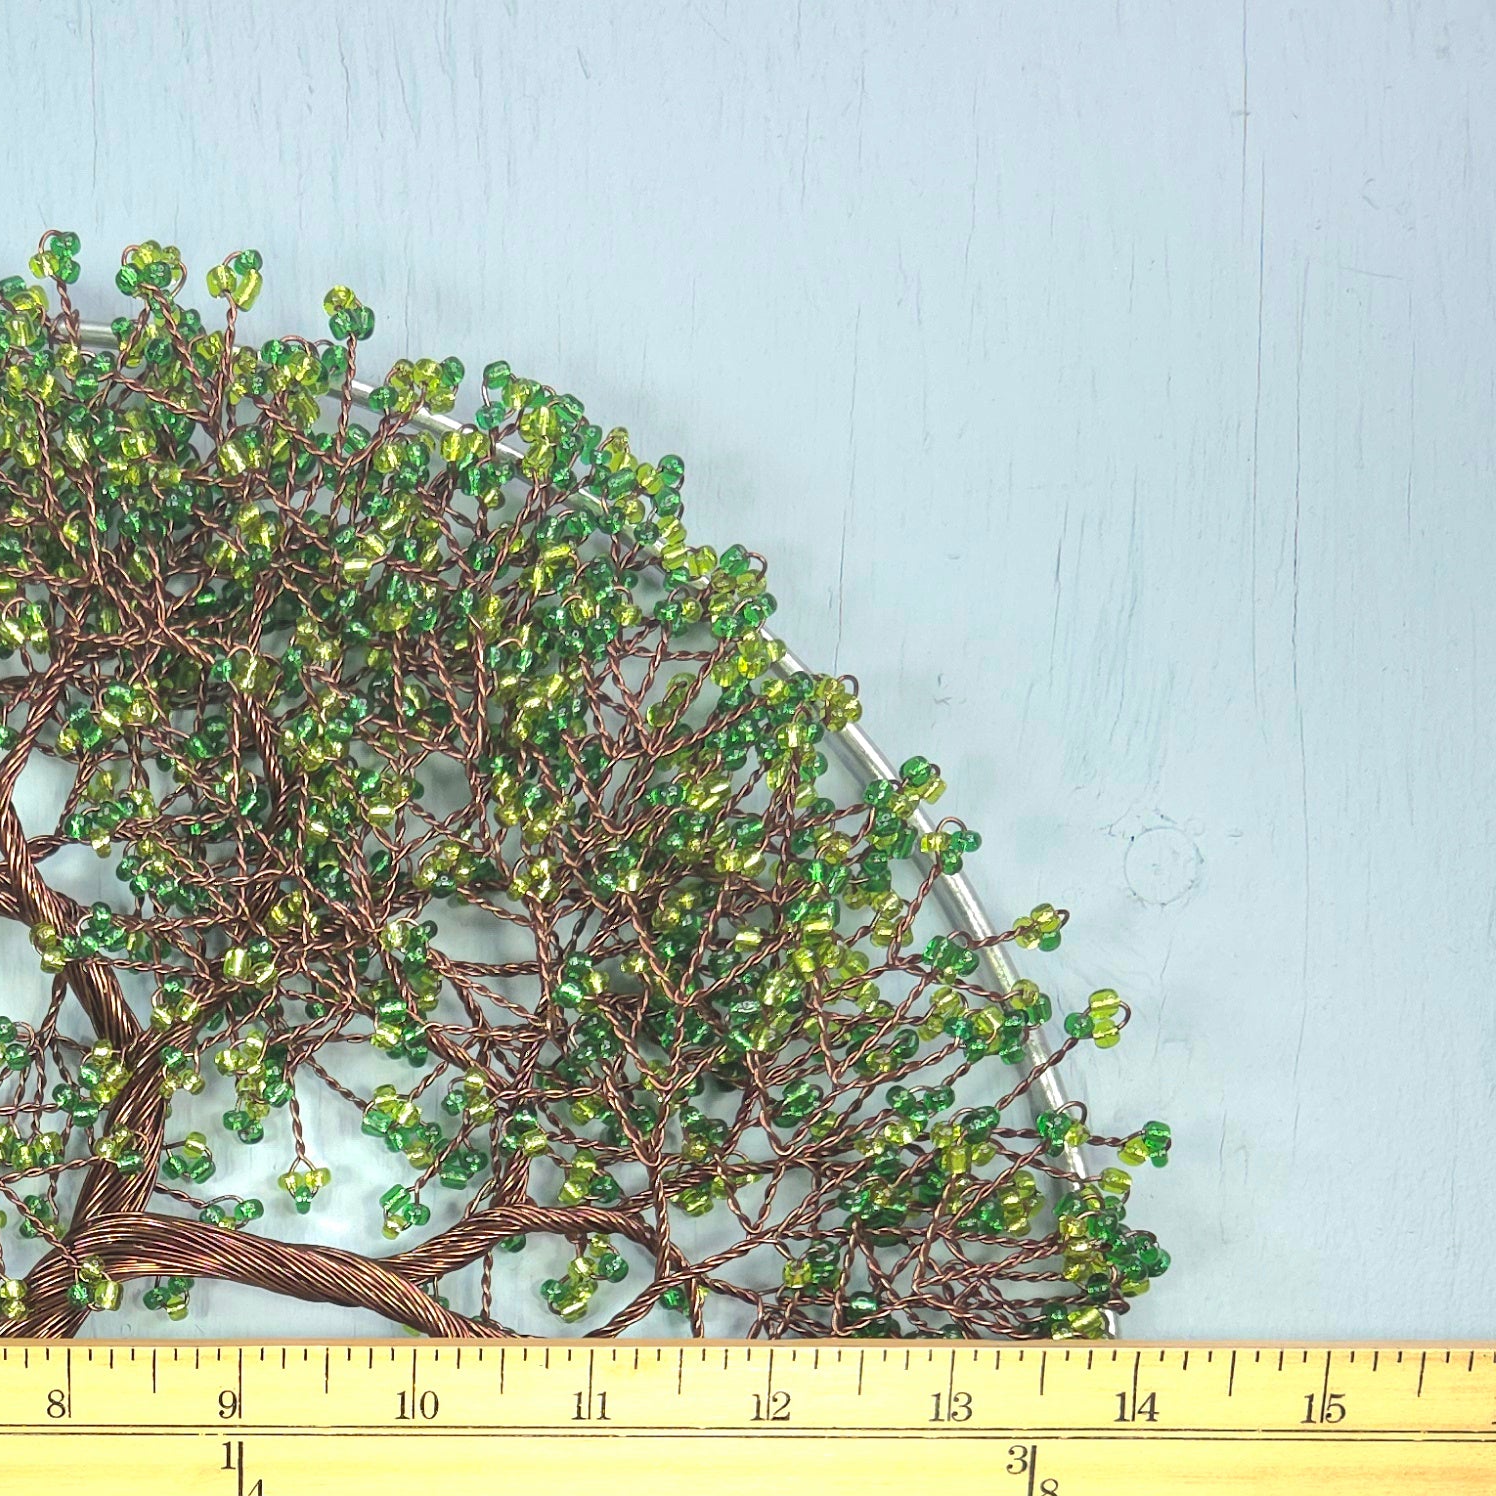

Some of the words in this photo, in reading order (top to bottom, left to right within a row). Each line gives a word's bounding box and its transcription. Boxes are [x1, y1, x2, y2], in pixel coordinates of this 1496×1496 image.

[47, 1390, 67, 1418] 8
[218, 1391, 238, 1419] 9
[395, 1391, 440, 1420] 10
[570, 1391, 611, 1420] 11
[749, 1392, 791, 1420] 12
[928, 1391, 974, 1422] 13
[1115, 1392, 1160, 1422] 14
[1304, 1393, 1346, 1423] 15
